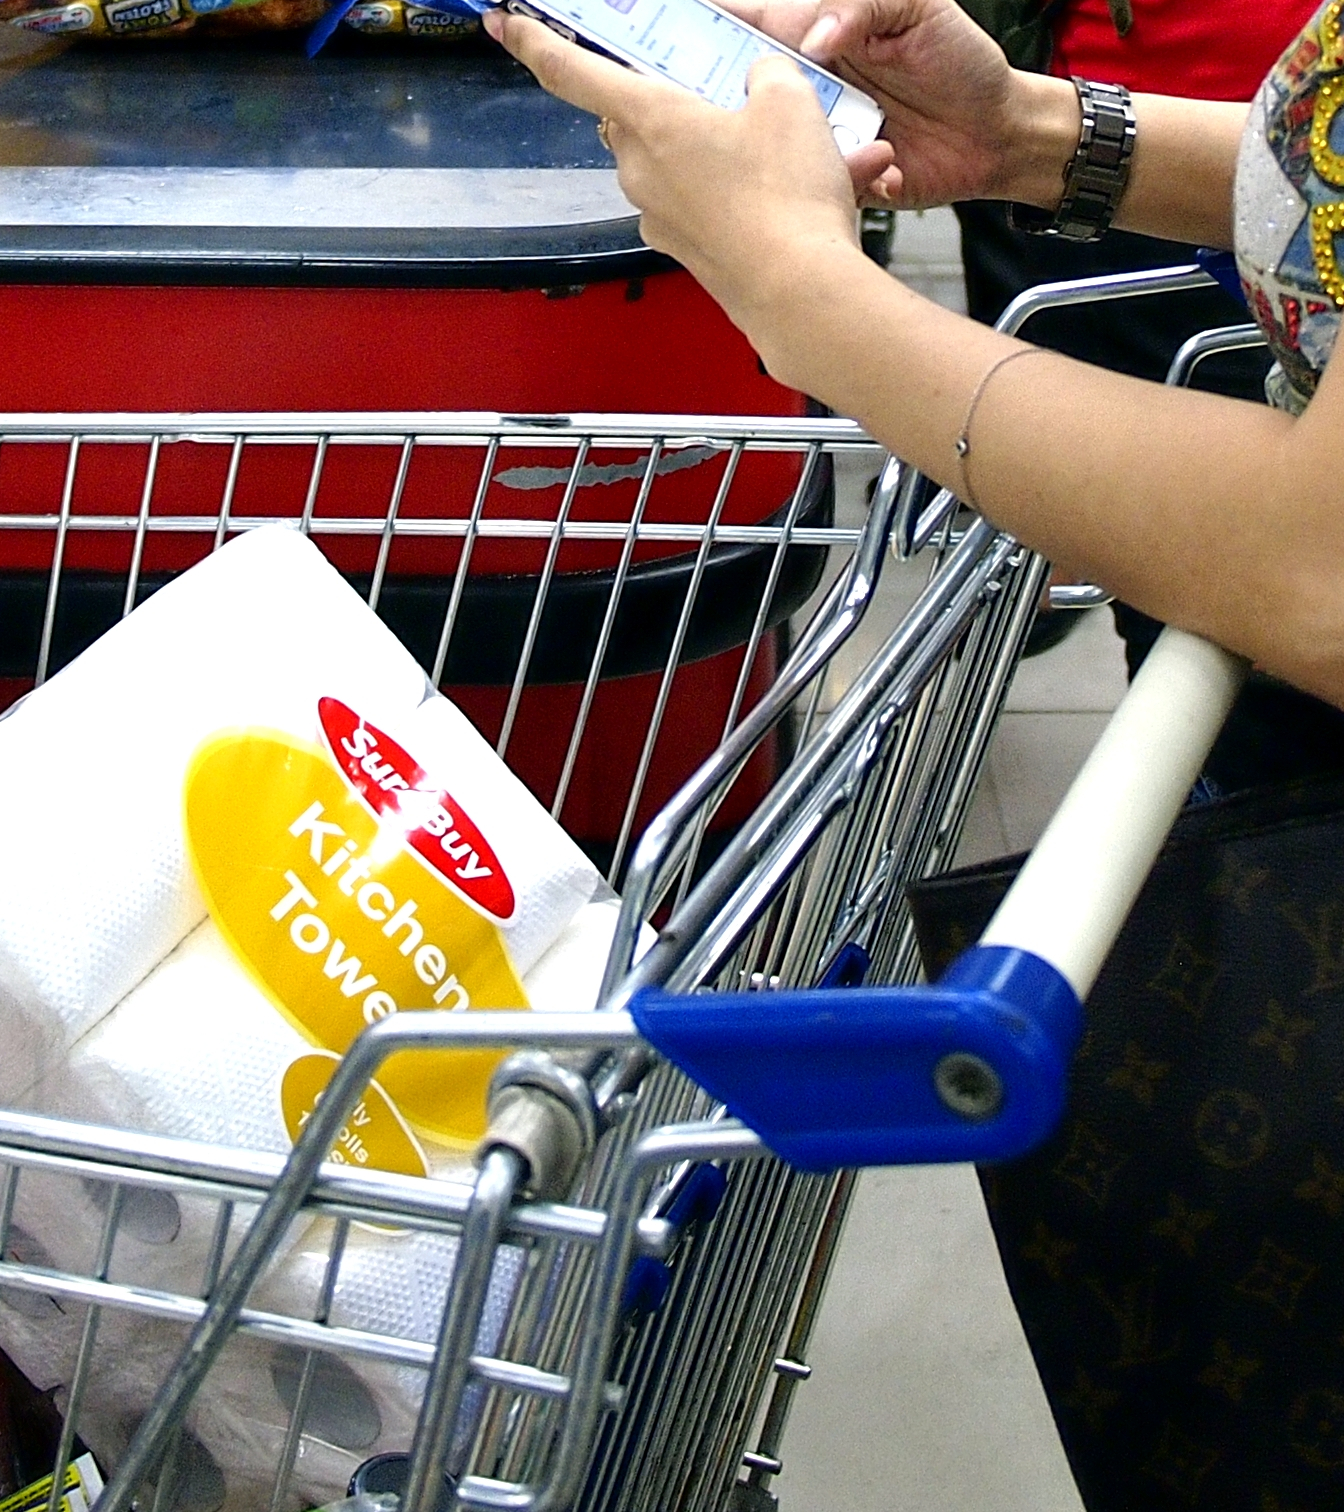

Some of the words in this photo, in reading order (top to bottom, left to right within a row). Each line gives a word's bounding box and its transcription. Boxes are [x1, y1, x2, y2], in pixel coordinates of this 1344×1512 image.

[339, 725, 421, 798] Sur
[421, 803, 493, 883] Buy
[268, 869, 401, 1028] Towe
[288, 799, 471, 1014] Kitchen
